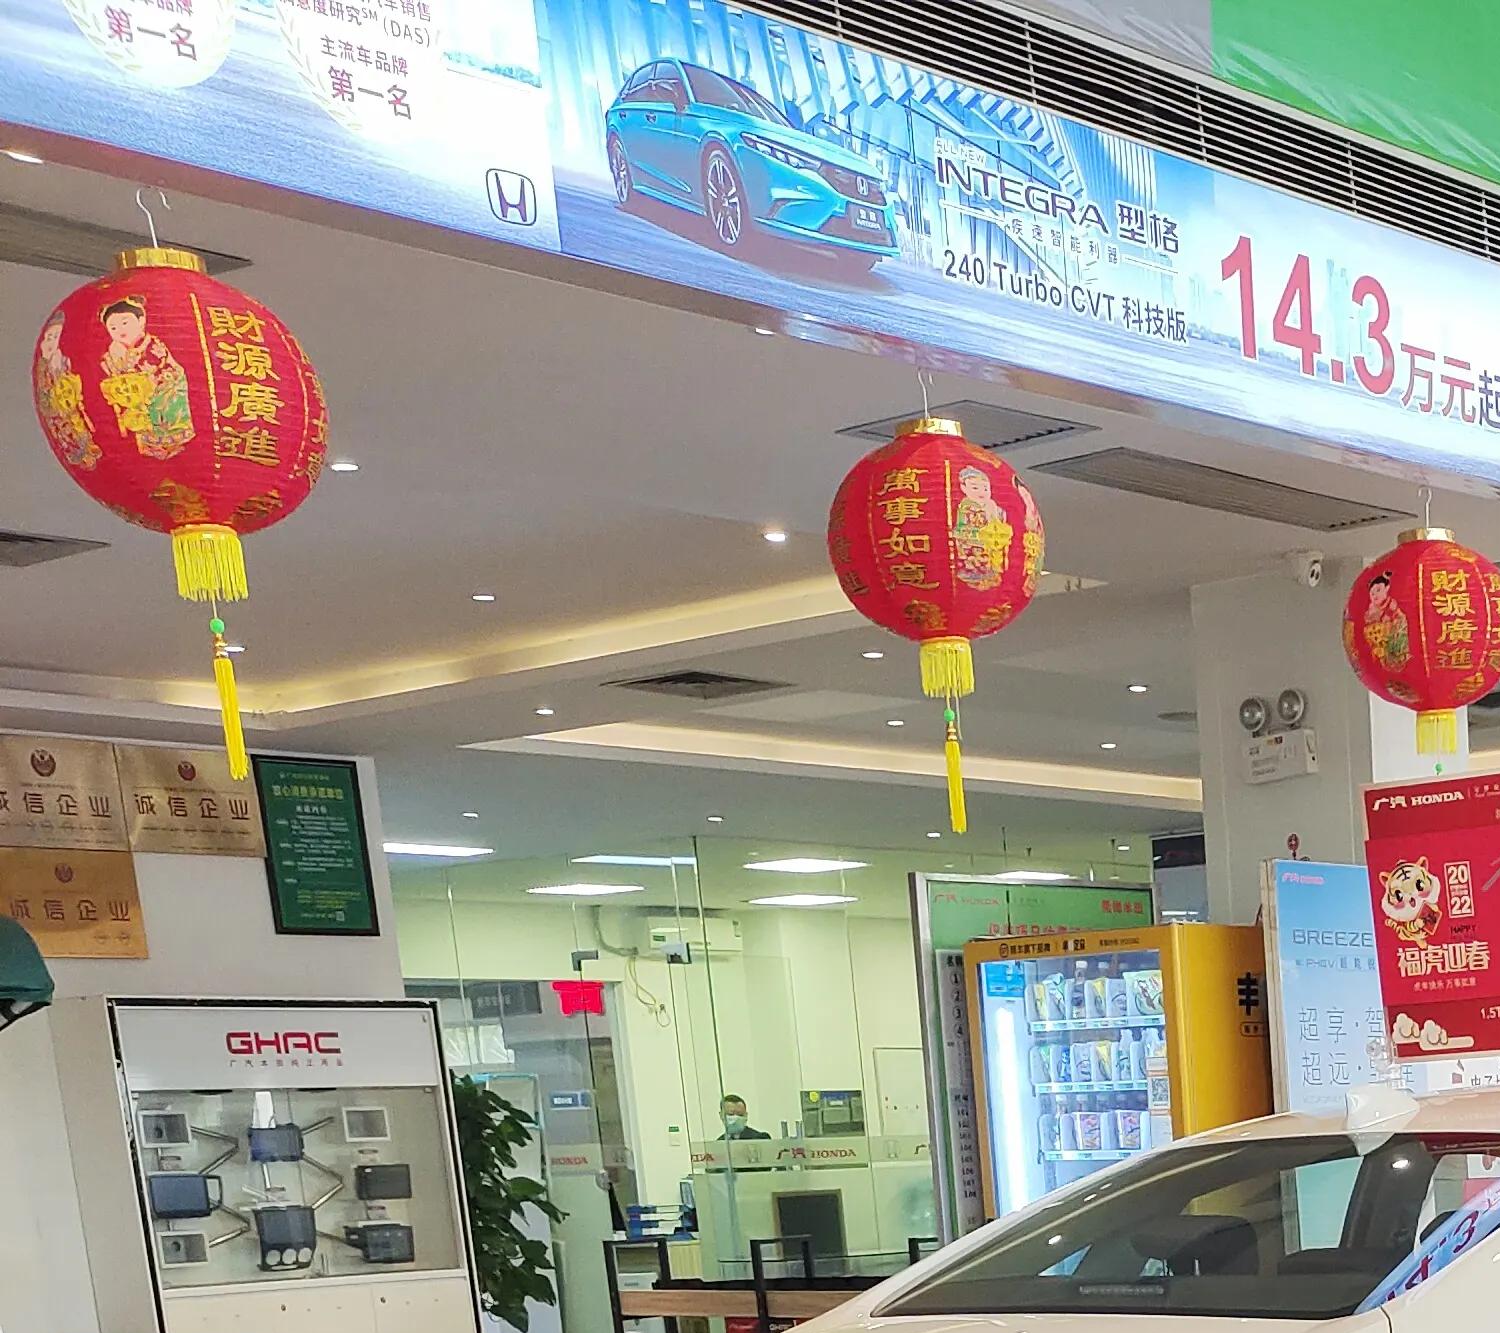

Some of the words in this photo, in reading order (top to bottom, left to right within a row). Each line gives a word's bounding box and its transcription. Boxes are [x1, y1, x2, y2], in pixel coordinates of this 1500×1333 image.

[106, 6, 197, 60] 第一名
[384, 16, 430, 48] (DAS)
[320, 35, 409, 78] 主流车品牌
[328, 65, 411, 120] 第一名
[938, 157, 1109, 234] INTEGRA
[1118, 204, 1179, 253] 型格
[944, 250, 985, 285] 240
[993, 262, 1063, 307] Turbo
[1071, 285, 1115, 321] CVT
[1122, 297, 1187, 343] 科技版
[1221, 236, 1395, 394] 14.3
[207, 306, 286, 467] 財源廣進
[876, 467, 940, 590] 萬事如意
[1431, 568, 1478, 669] 財源廣進
[134, 793, 250, 820] 诚信企业
[1411, 791, 1464, 806] HONDA
[1447, 865, 1468, 884] 20
[10, 900, 131, 922] 诚信企业
[1451, 896, 1471, 915] 22
[1293, 929, 1373, 947] BREEZE
[1397, 941, 1490, 977] 福虎迎春
[226, 1032, 341, 1054] GHAC
[811, 1148, 857, 1160] HONDA
